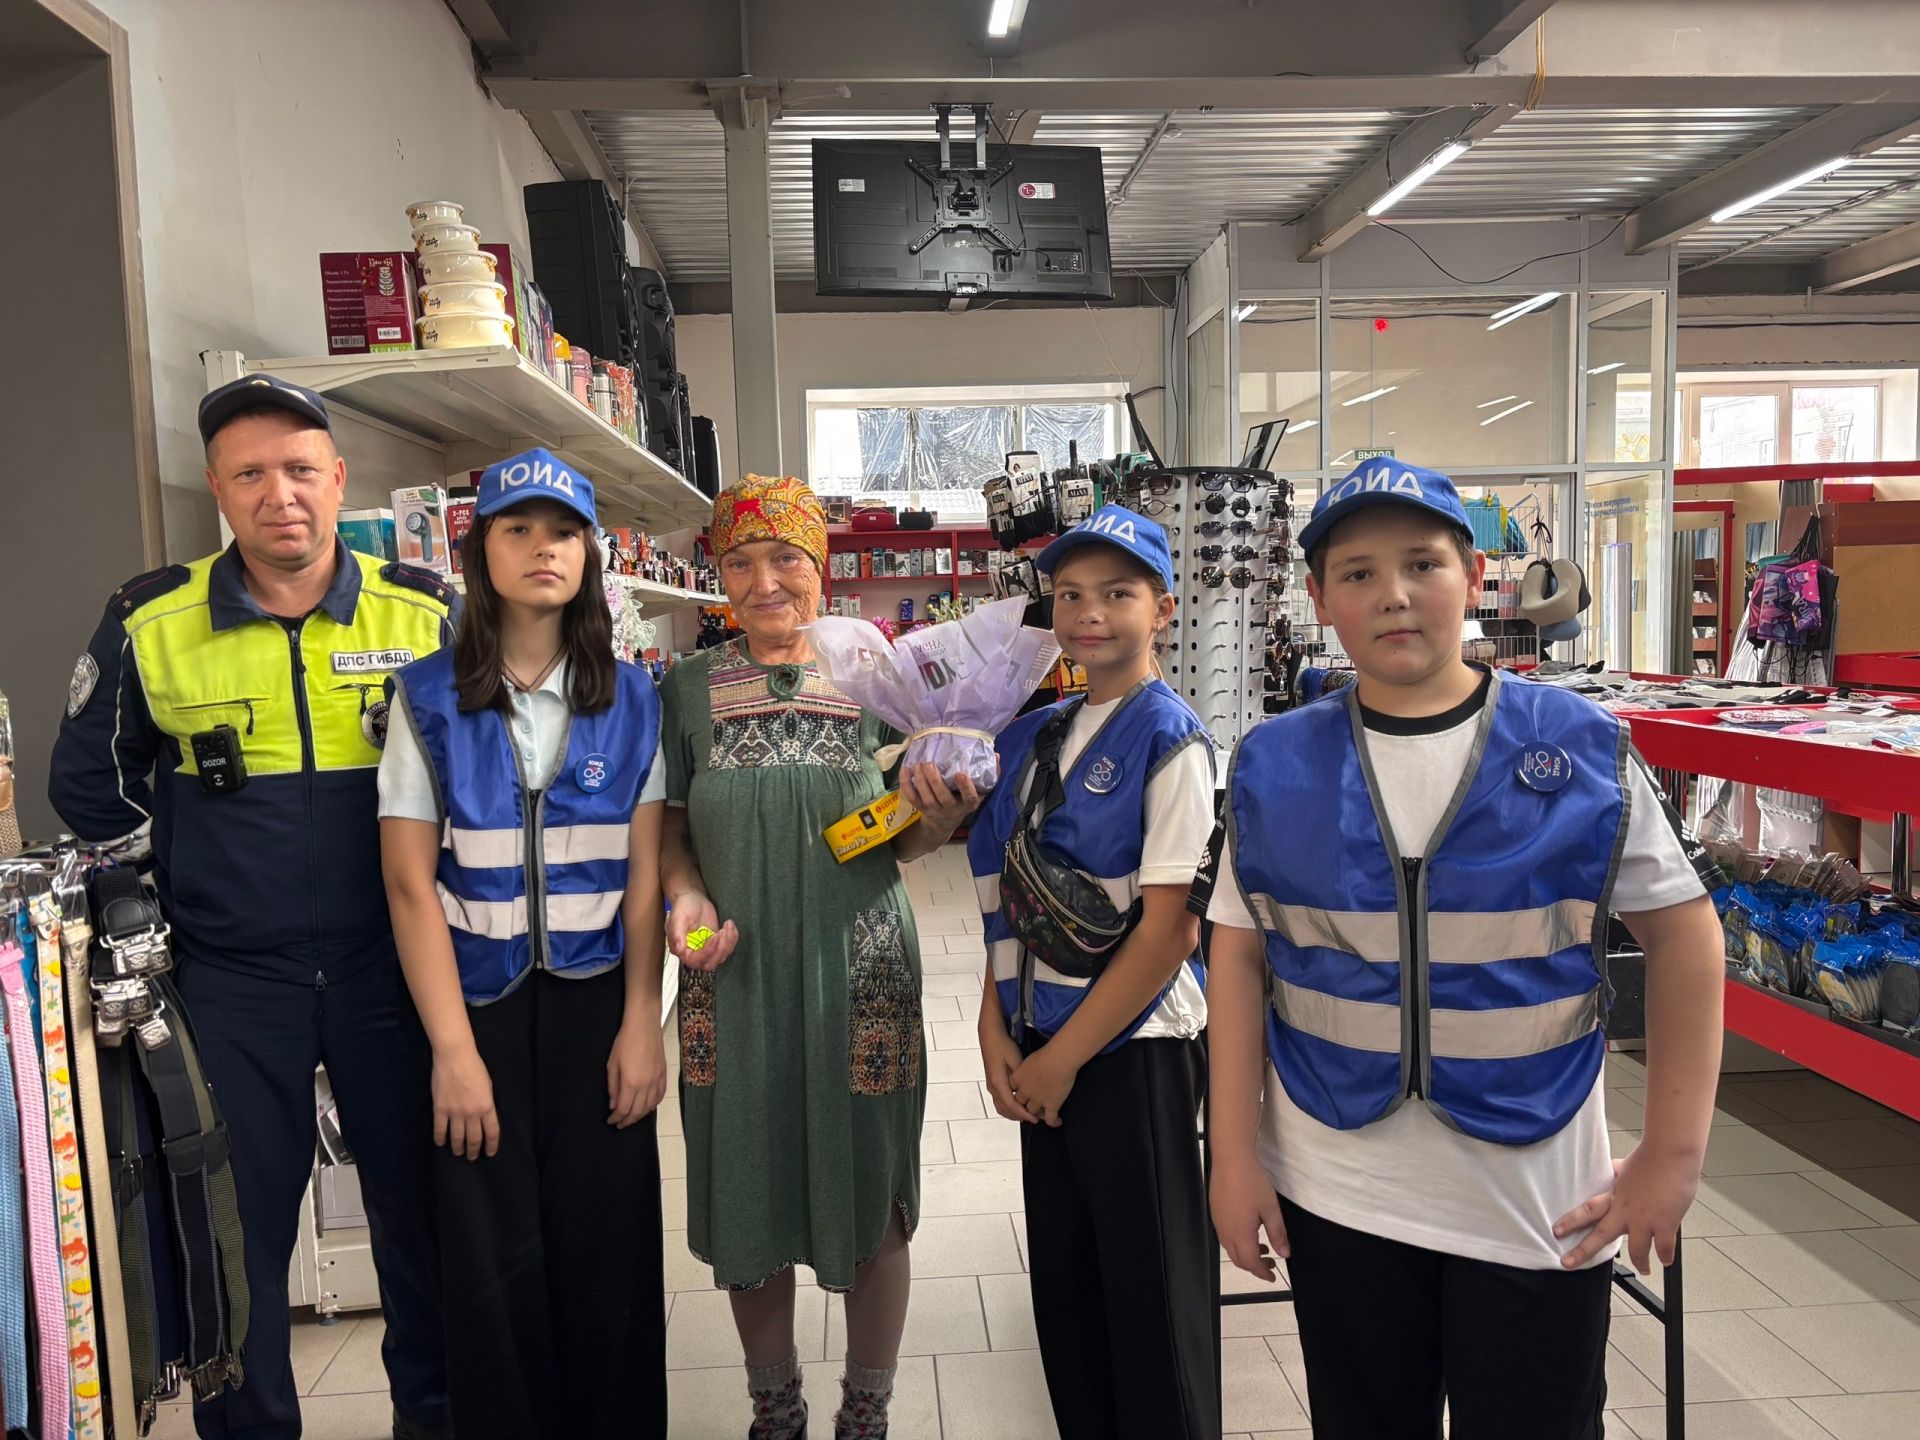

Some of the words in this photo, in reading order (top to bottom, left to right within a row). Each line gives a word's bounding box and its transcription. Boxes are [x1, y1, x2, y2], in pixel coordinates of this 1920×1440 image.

[1358, 450, 1391, 460] ВЫХОД
[501, 461, 575, 498] ЮИД
[1328, 467, 1423, 508] ЮИД
[337, 656, 365, 668] ДПС
[368, 652, 411, 664] ГИБДД
[202, 757, 227, 768] DOZOR
